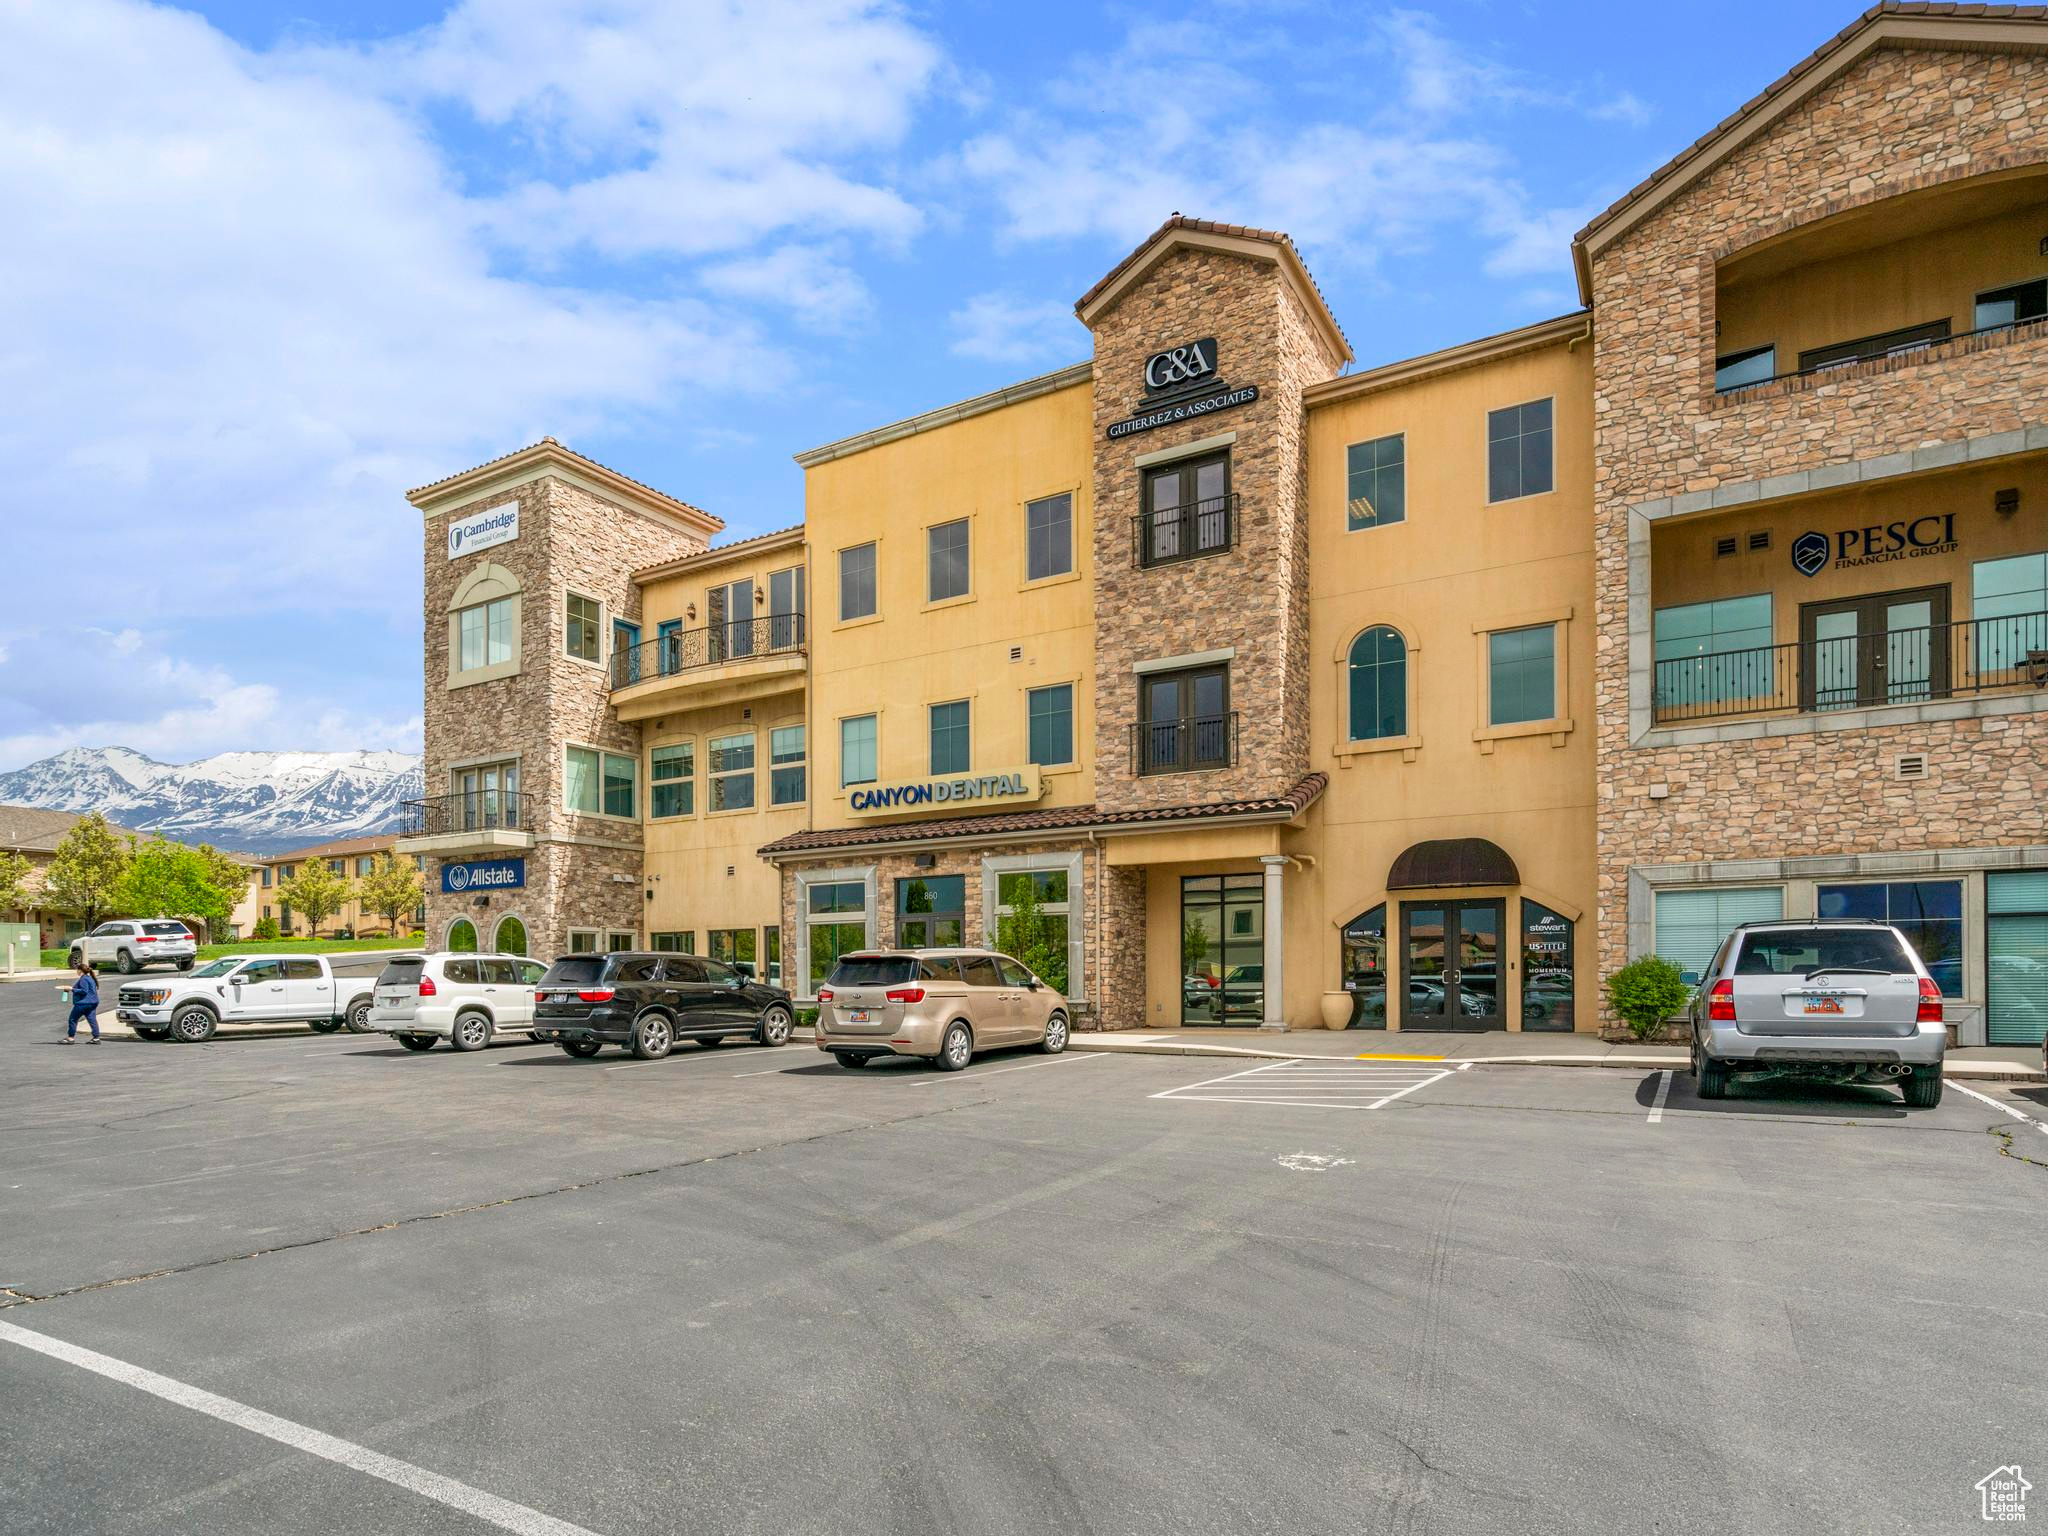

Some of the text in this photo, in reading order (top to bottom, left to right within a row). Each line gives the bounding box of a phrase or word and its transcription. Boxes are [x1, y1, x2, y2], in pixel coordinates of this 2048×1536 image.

[1147, 343, 1213, 388] G&A
[1110, 387, 1255, 436] GUTIERREZ & ASSOCIATES
[464, 513, 516, 538] Cambridge
[471, 529, 509, 547] Financial Group
[1835, 513, 1957, 560] PESCI
[1835, 543, 1958, 570] FINANCIAL GROUP
[851, 774, 1028, 811] CANYON DENTAL
[924, 891, 938, 900] 860
[1529, 924, 1566, 932] stewart
